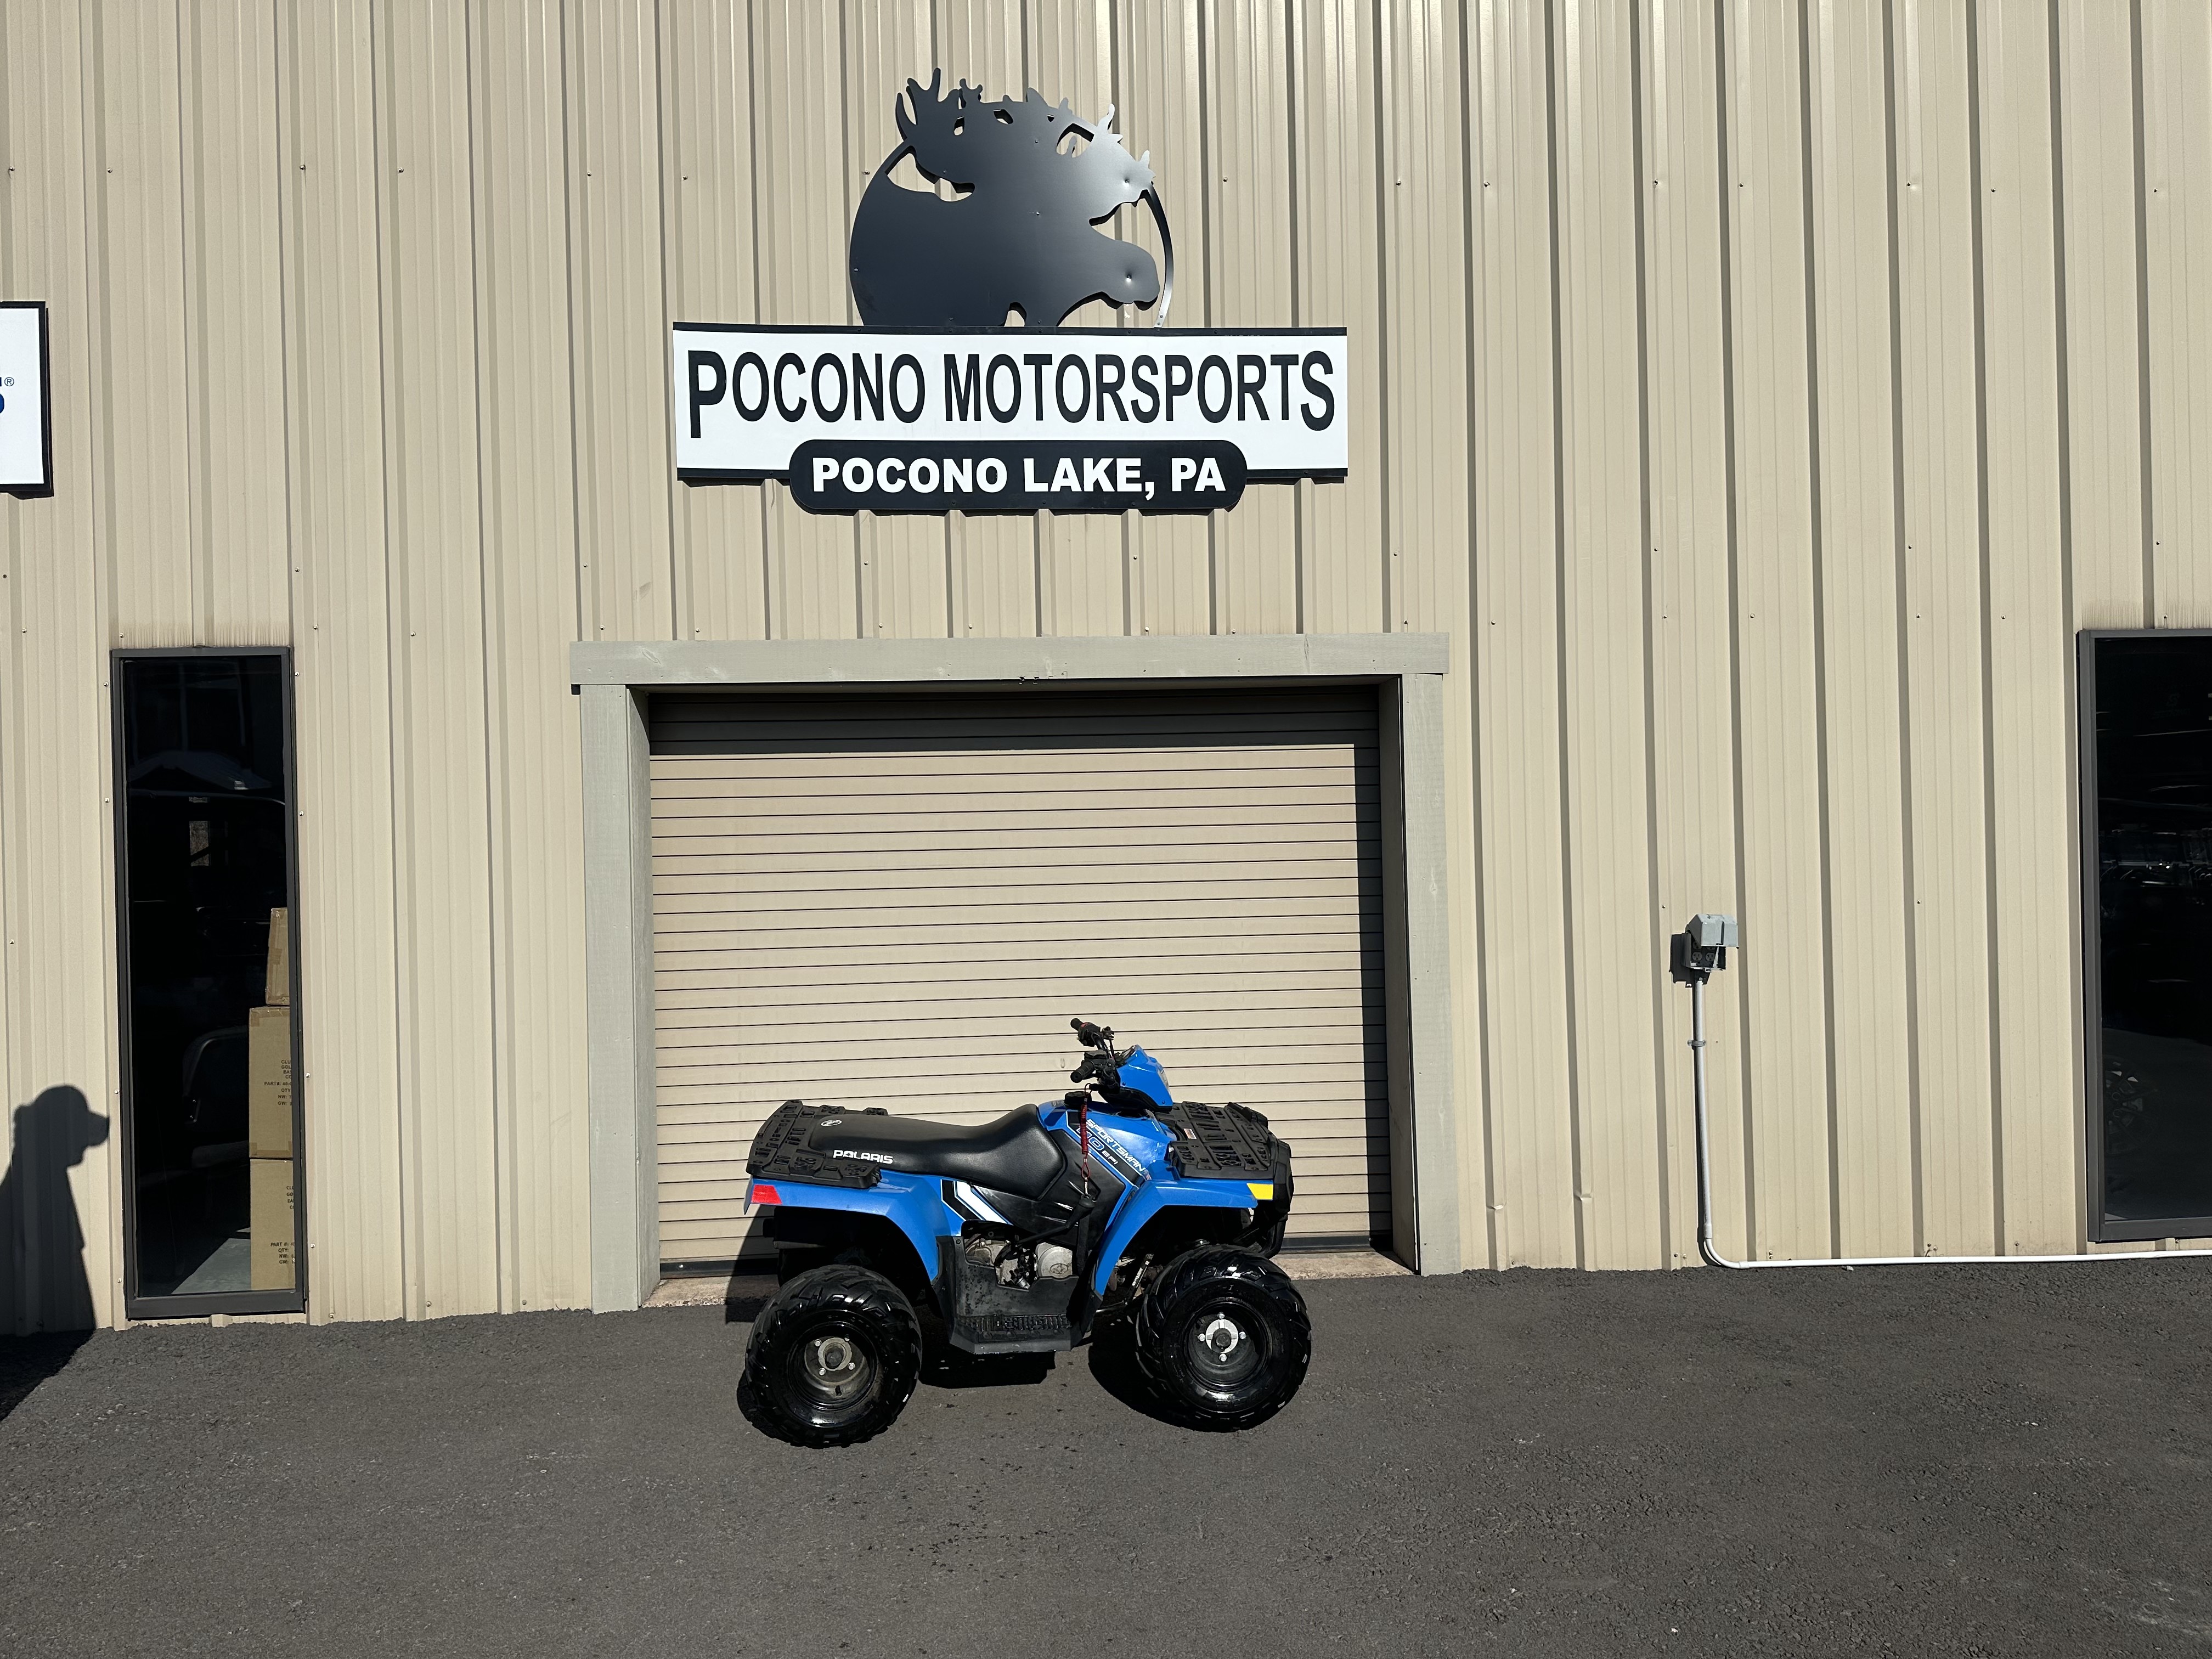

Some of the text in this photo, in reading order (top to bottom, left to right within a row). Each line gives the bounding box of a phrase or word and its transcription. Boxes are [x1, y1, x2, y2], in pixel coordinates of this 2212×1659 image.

[687, 350, 1335, 438] POCONO MOTORSPORTS
[812, 457, 1226, 501] POCONO LAKE, PA
[833, 1149, 893, 1164] POLARIS
[1086, 1119, 1146, 1172] SPORTSMAN
